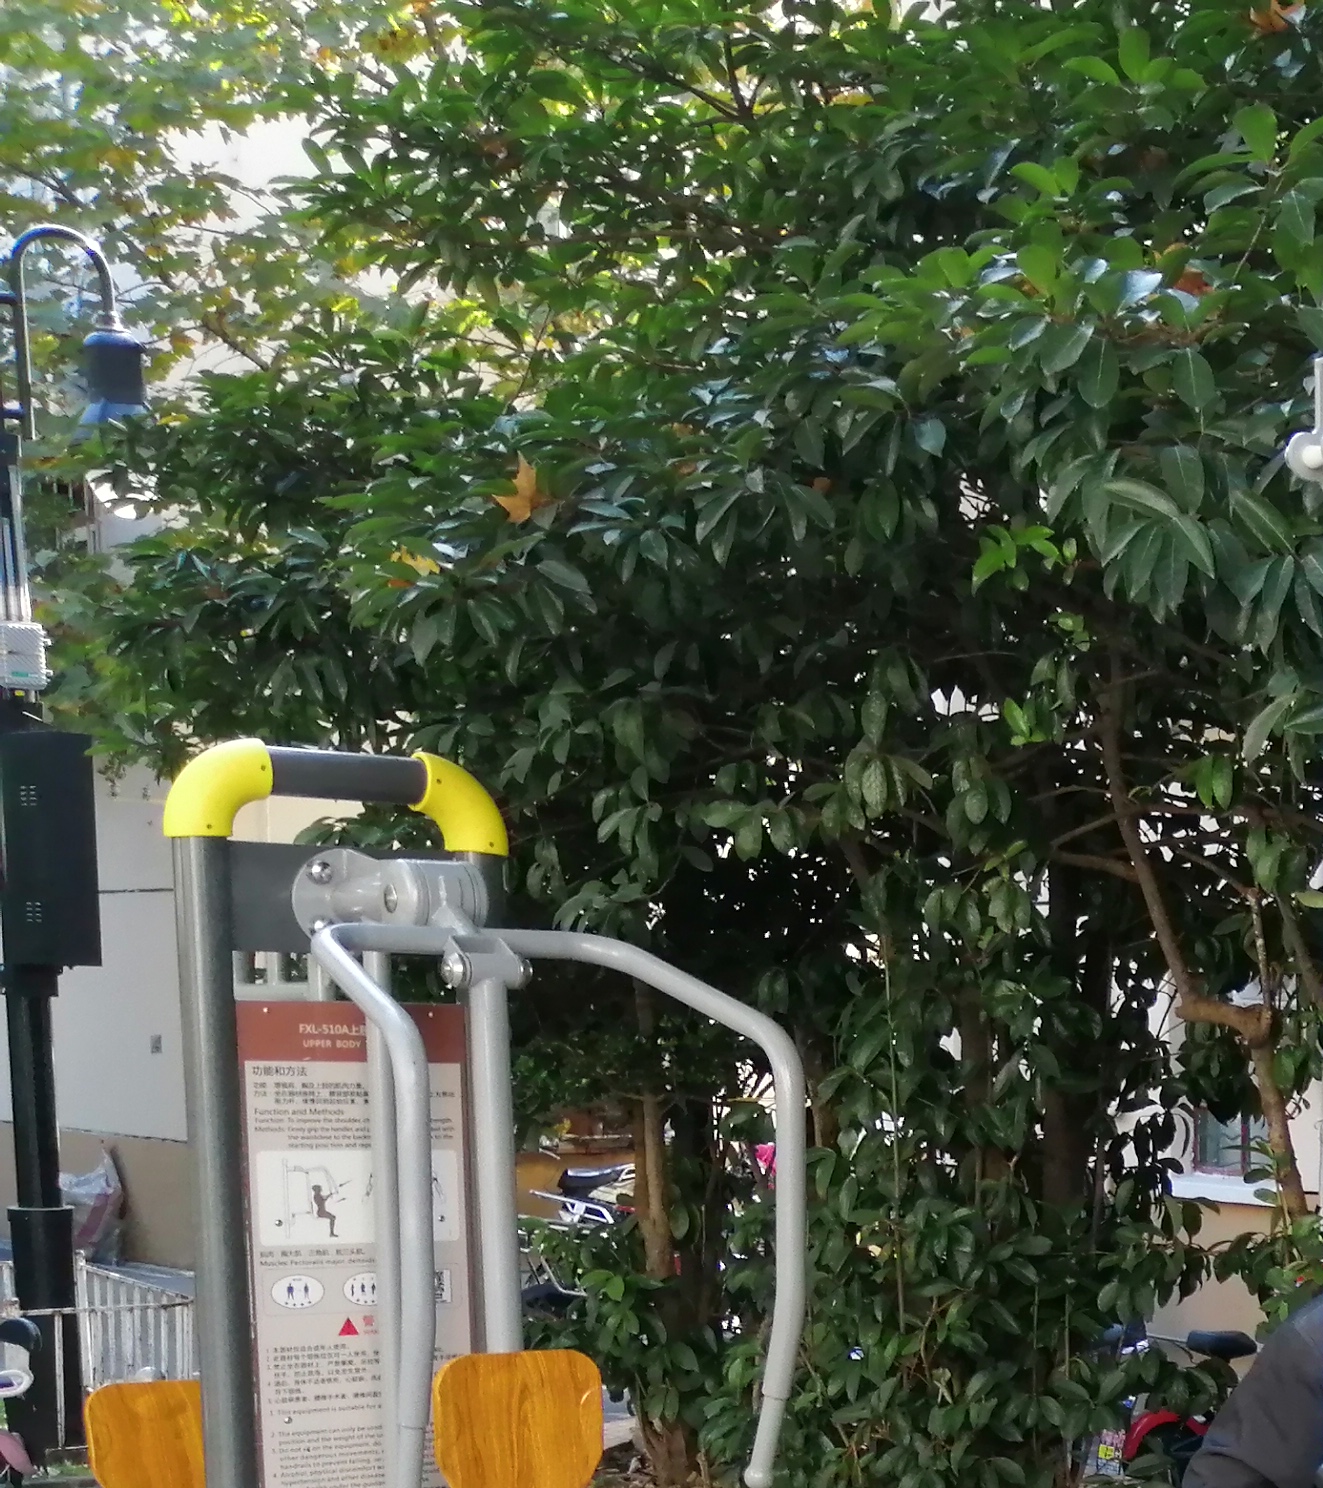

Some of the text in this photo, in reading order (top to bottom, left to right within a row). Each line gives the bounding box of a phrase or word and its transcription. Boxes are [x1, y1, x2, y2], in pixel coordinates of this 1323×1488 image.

[303, 1039, 361, 1048] UPPER BODY
[252, 1066, 308, 1077] 功能和方法
[254, 1108, 344, 1116] Function and Methods
